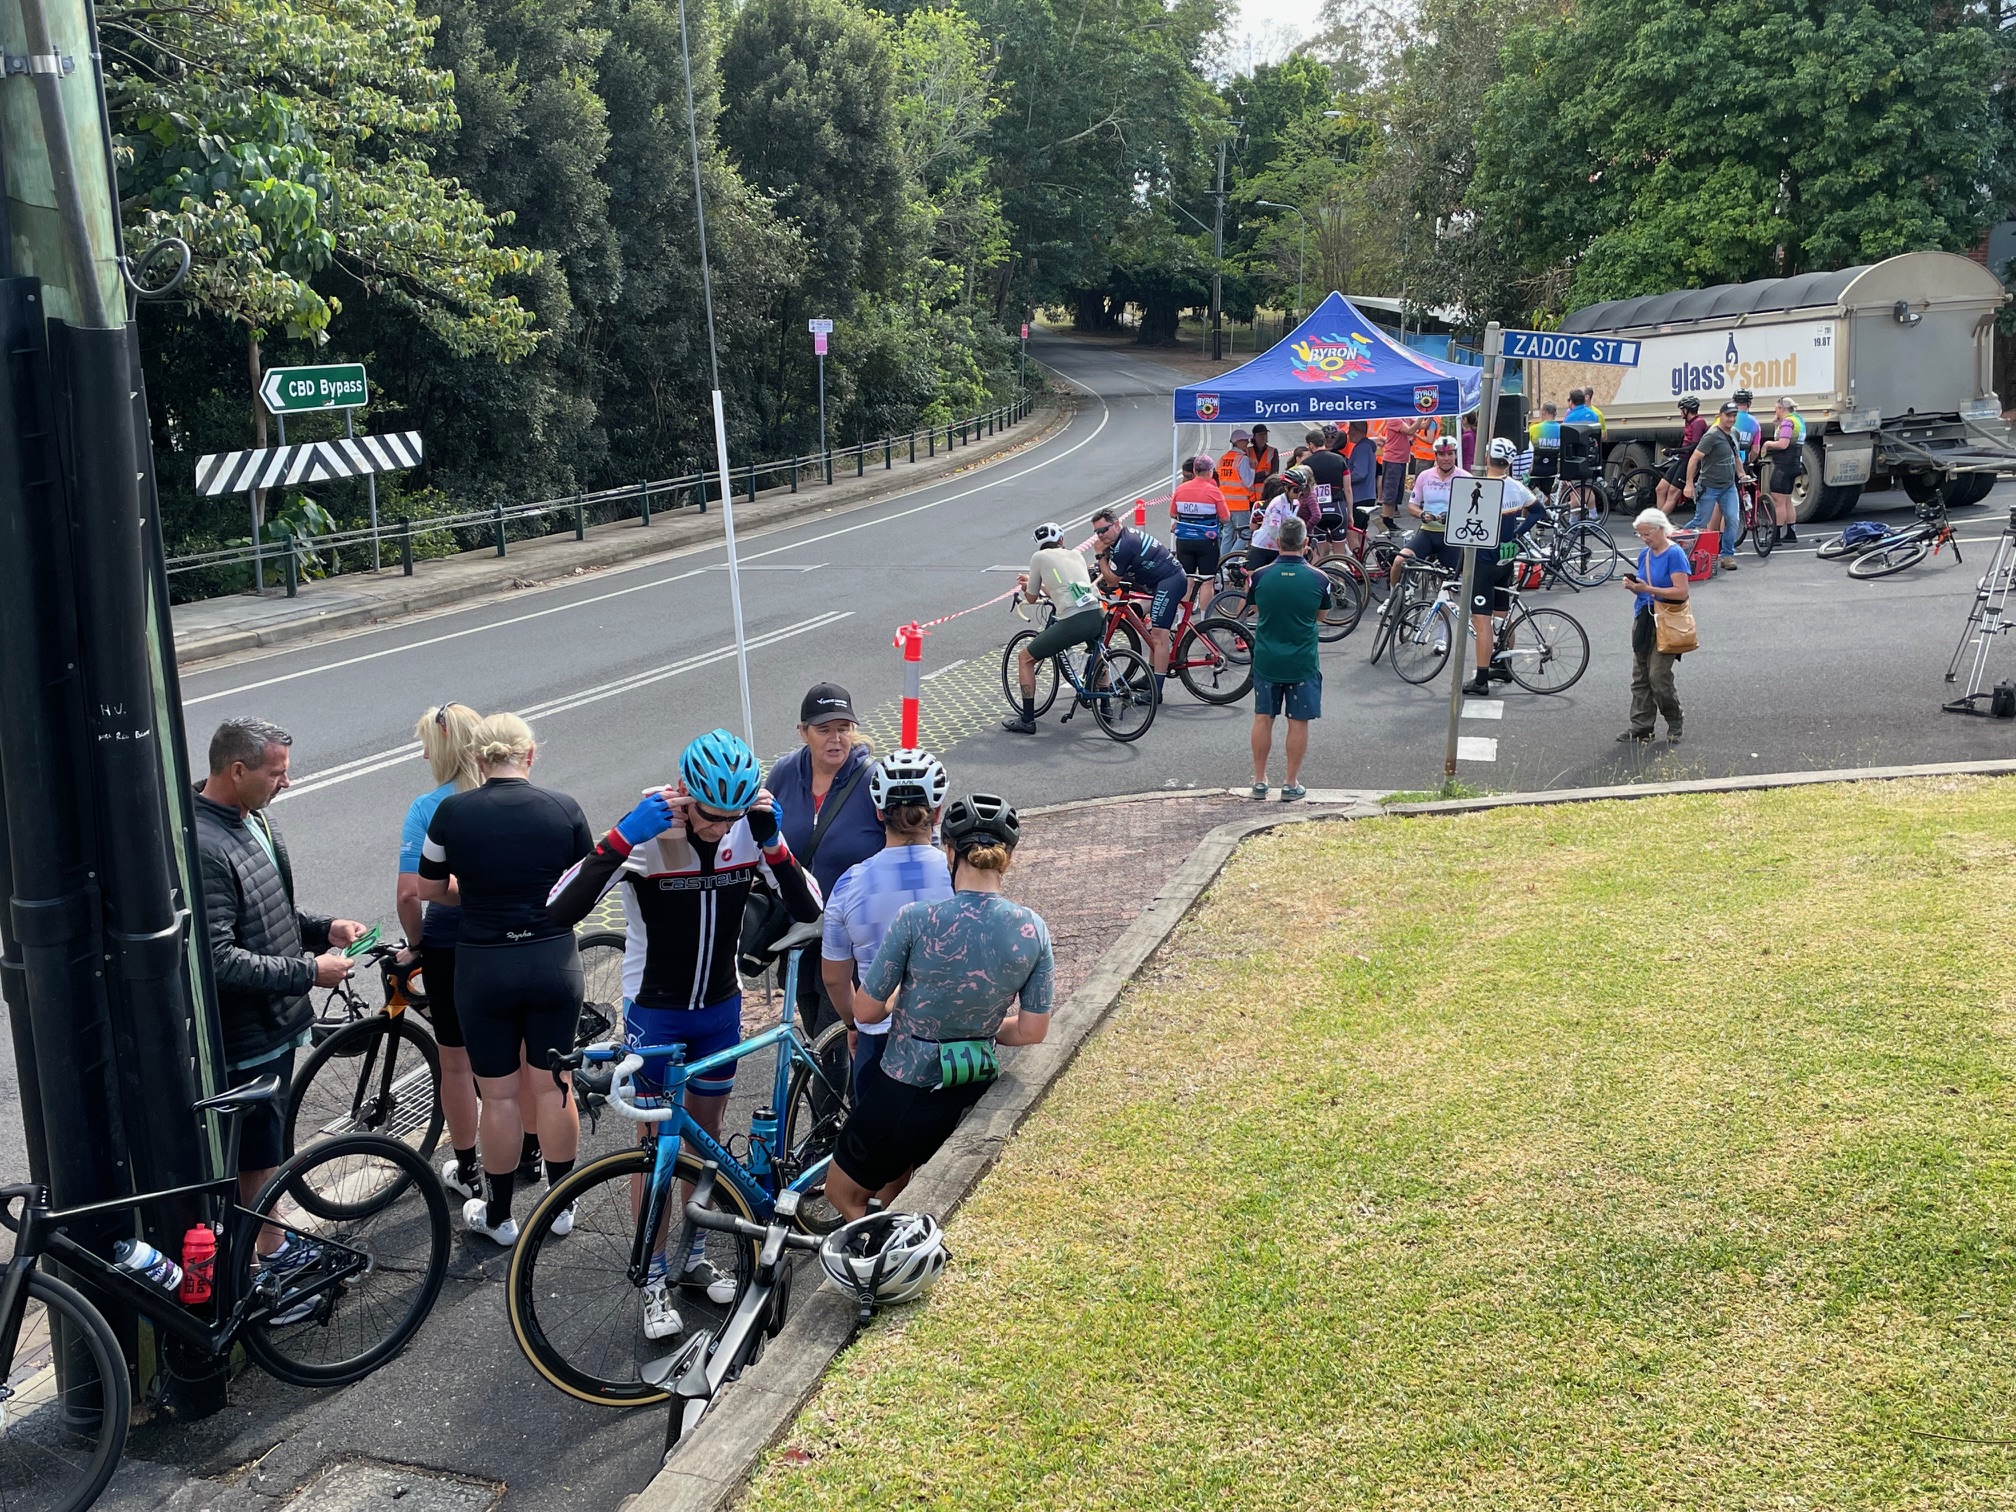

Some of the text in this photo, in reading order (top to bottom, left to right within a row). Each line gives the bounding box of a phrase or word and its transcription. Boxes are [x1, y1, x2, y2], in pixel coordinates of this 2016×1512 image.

[1513, 335, 1618, 362] ZADOC ST
[1813, 336, 1831, 347] 19.8T
[1308, 346, 1358, 362] BYRON
[1671, 362, 1725, 396] glass
[1739, 353, 1797, 388] sand
[288, 378, 363, 398] CBD Bypass
[1414, 389, 1438, 400] BYRON
[1196, 397, 1219, 407] BYRON
[1254, 396, 1377, 418] Byron Breakers
[1314, 485, 1331, 497] 176
[1183, 502, 1199, 513] RCA
[942, 1046, 996, 1086] 114
[696, 1128, 756, 1189] COLNAGO
